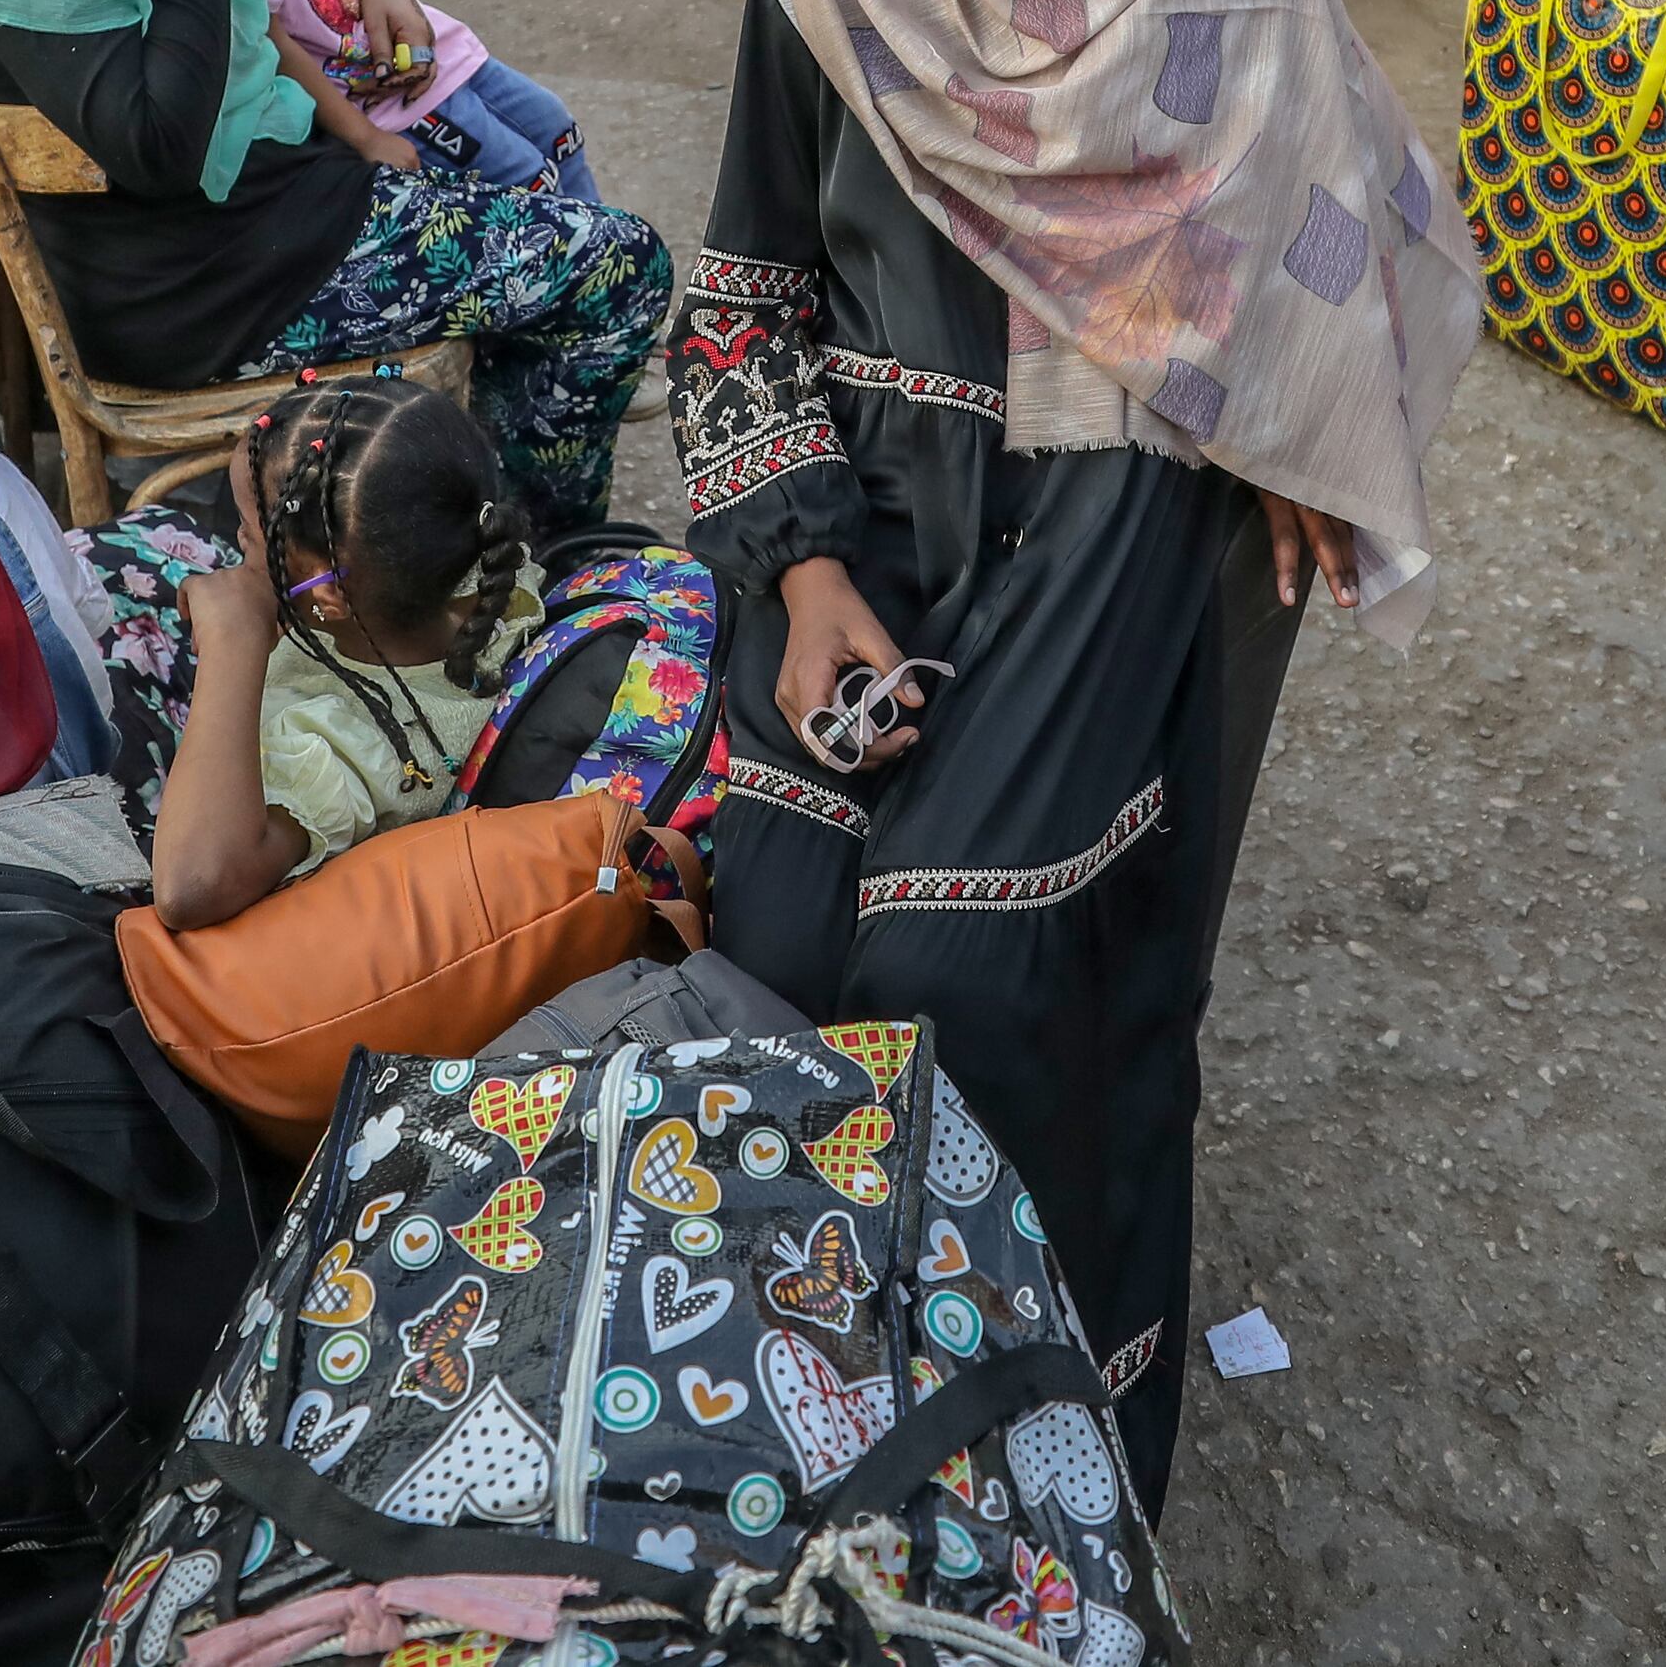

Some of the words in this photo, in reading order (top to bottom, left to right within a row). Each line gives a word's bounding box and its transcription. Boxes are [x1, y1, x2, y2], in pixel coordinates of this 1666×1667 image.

[749, 1035, 800, 1062] Miss
[796, 1054, 841, 1090] you
[419, 1127, 454, 1155] you
[450, 1141, 493, 1175] Miss
[608, 1200, 648, 1266] Miss
